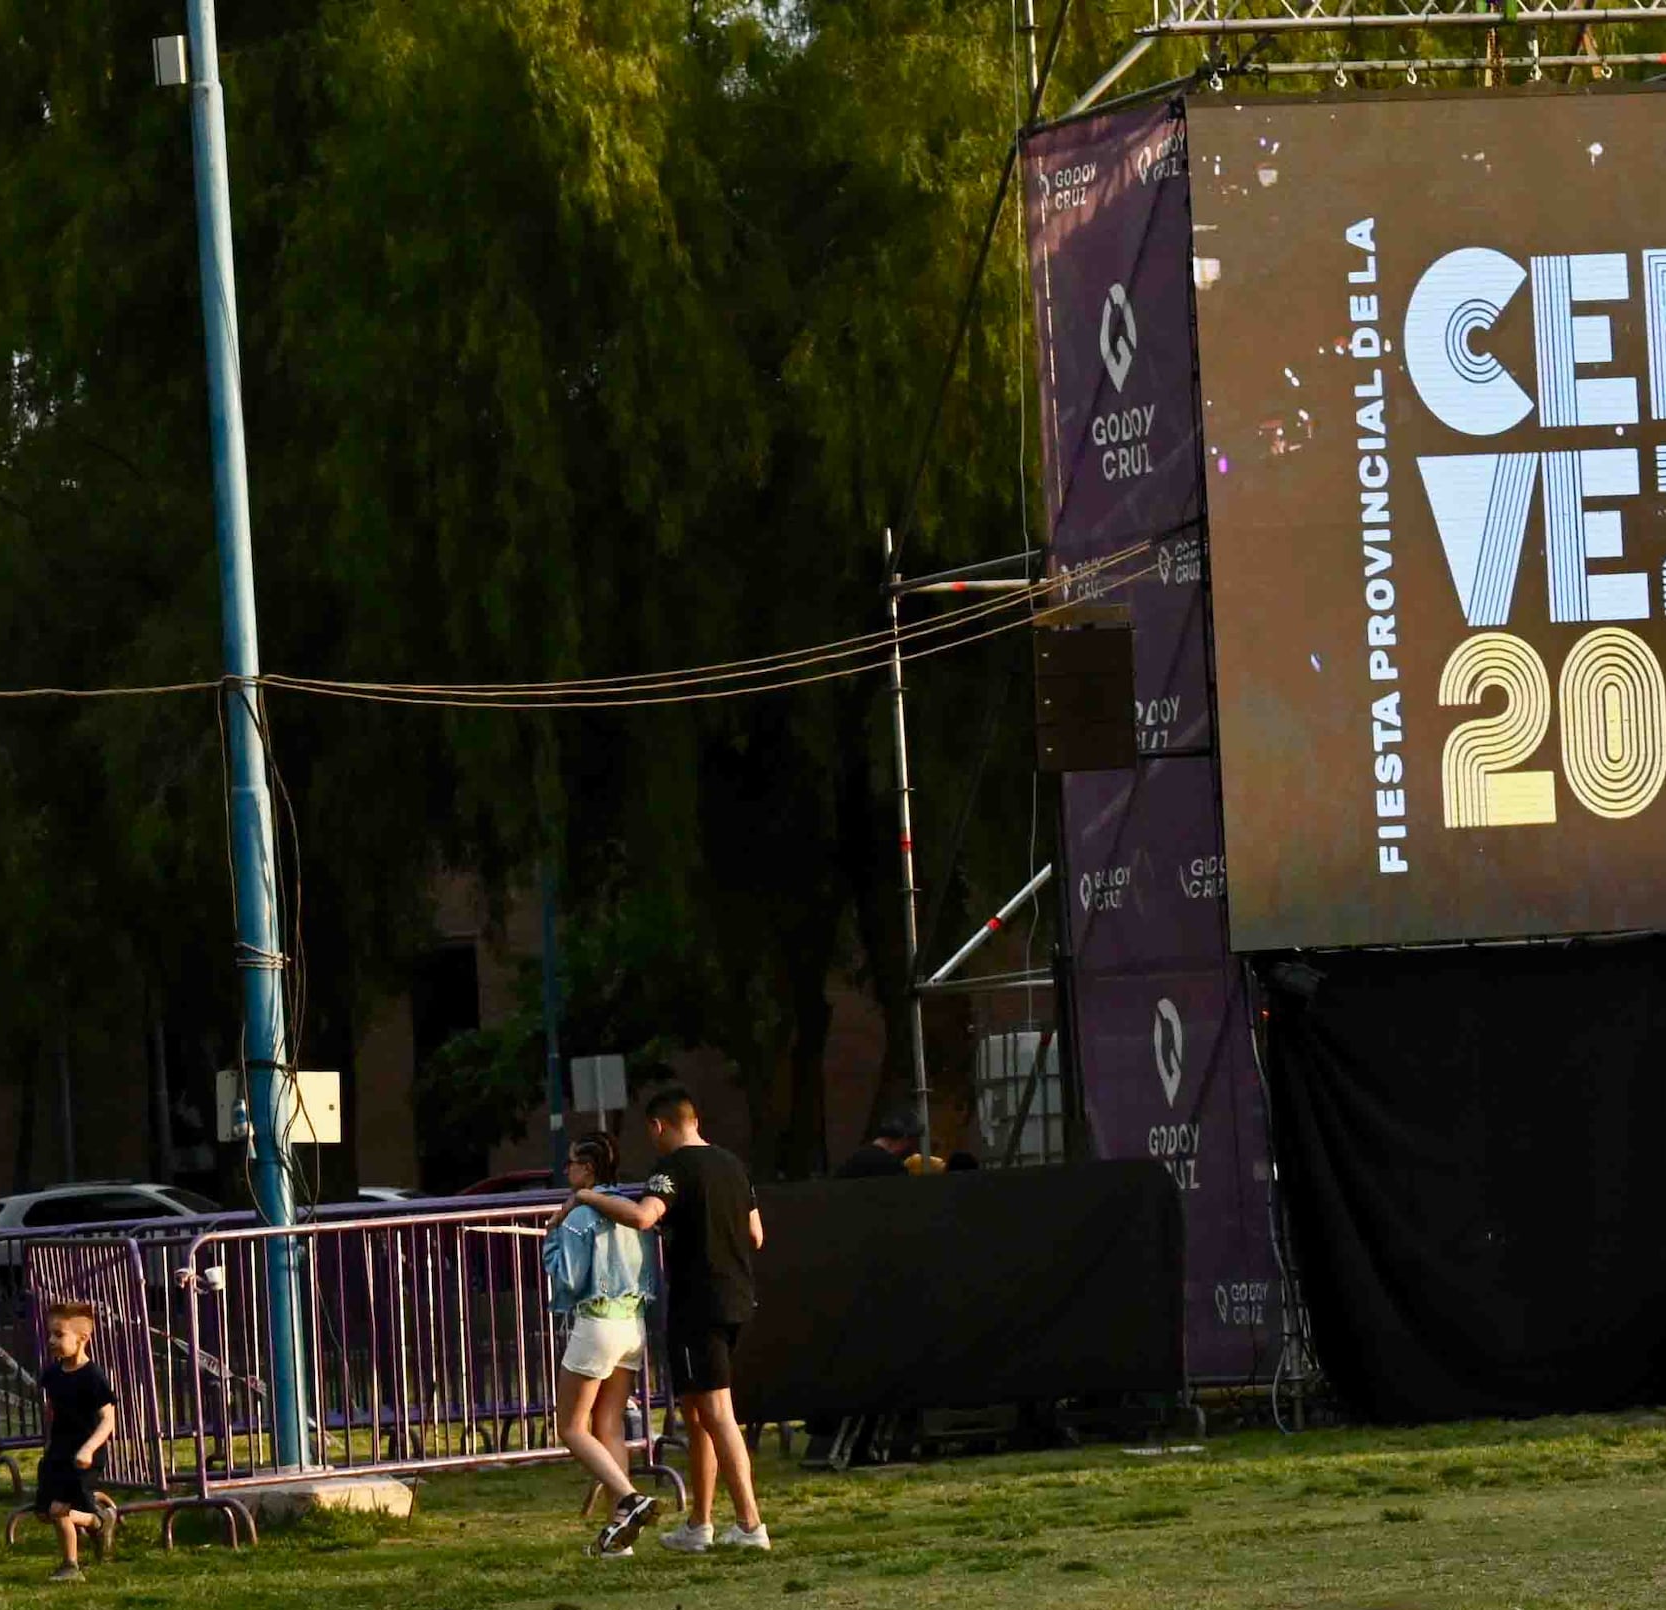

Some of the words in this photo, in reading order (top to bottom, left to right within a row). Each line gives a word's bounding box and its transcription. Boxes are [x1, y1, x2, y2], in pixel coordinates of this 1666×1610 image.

[1054, 162, 1097, 188] GODOY
[1054, 187, 1087, 210] CRUZ
[1345, 216, 1377, 284] LA
[1349, 294, 1382, 359] DE
[1091, 404, 1156, 447] GODOY
[1102, 442, 1153, 481] CRUZ
[1353, 369, 1399, 681] PROVINCIAL
[1372, 690, 1409, 874] FIESTA
[1148, 1123, 1200, 1157] GODOY
